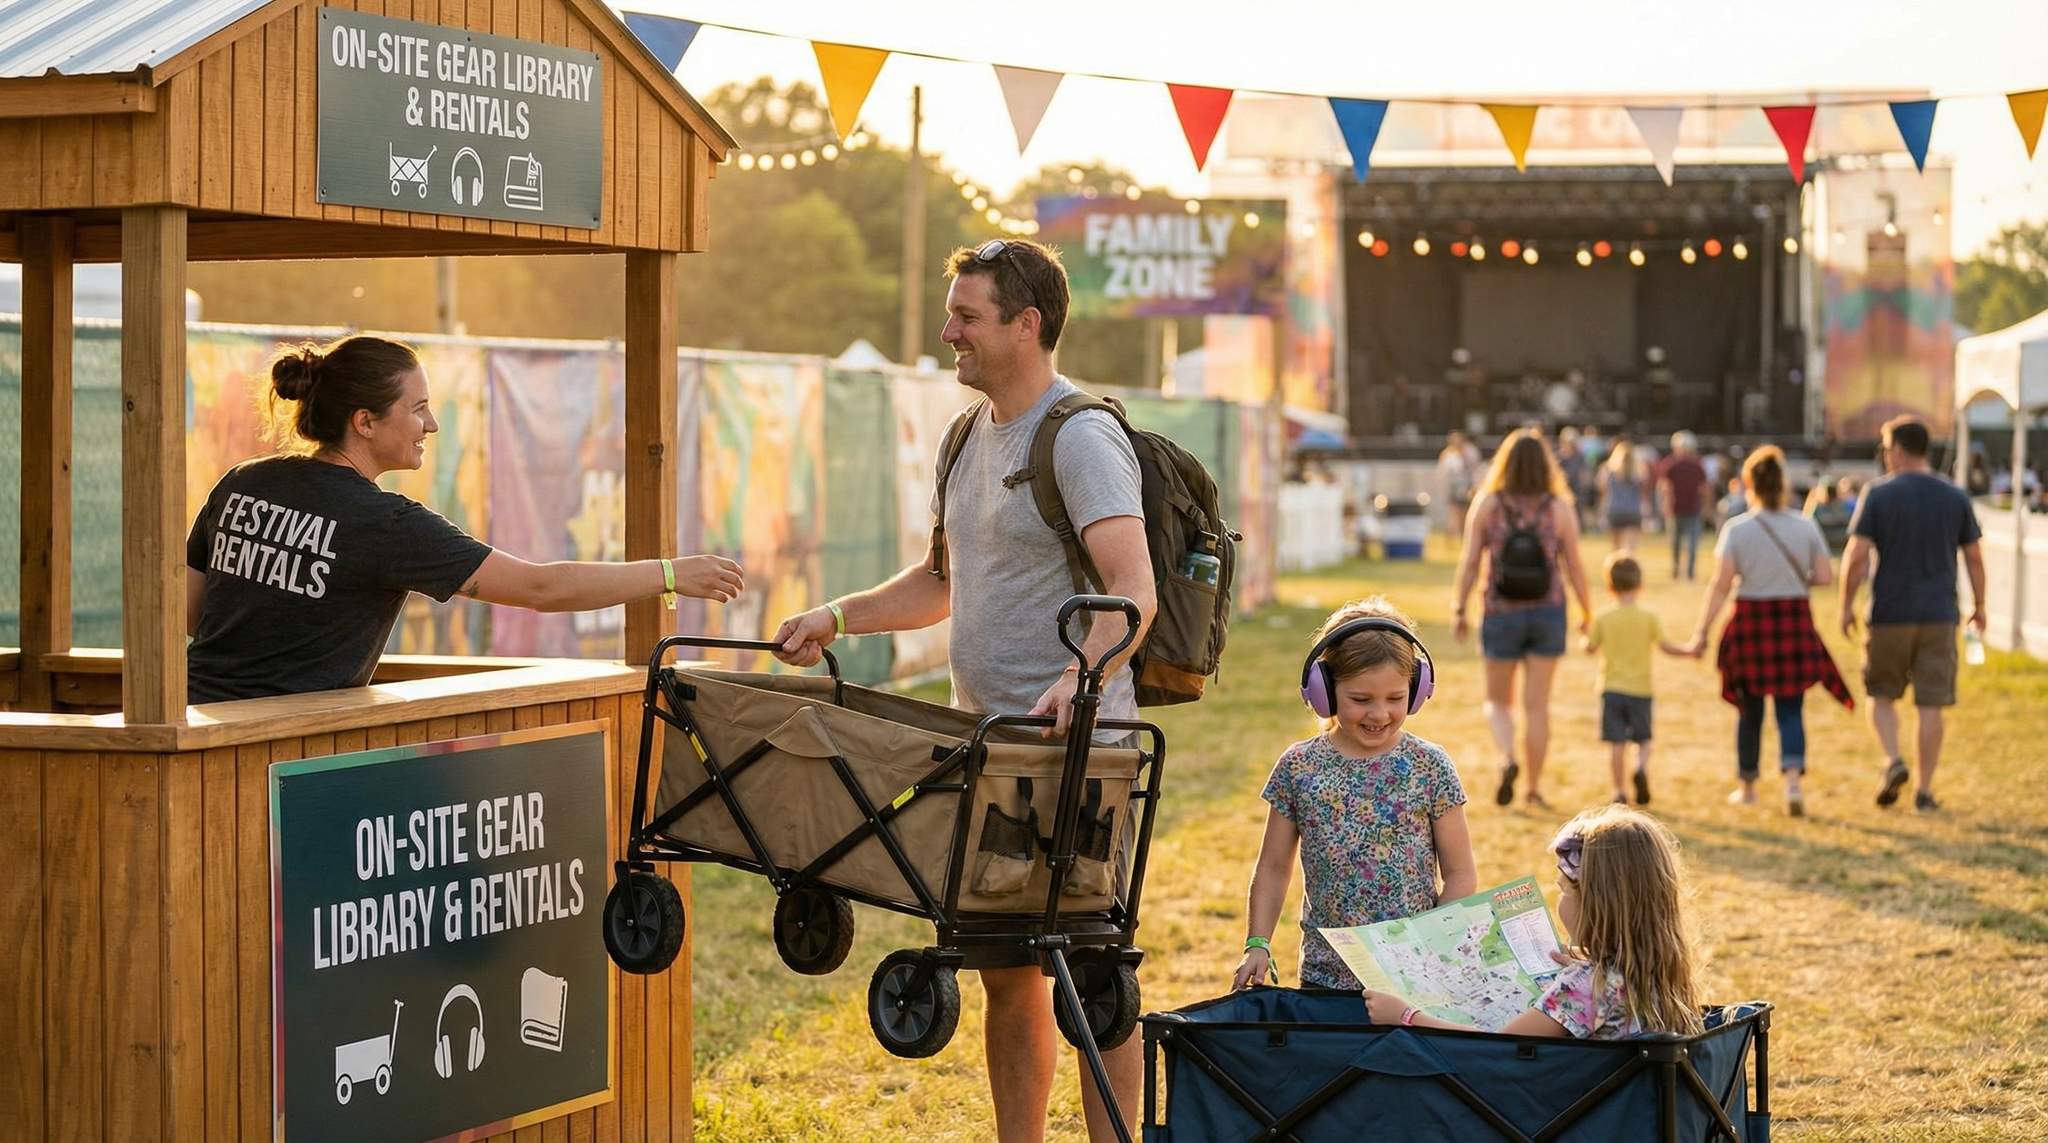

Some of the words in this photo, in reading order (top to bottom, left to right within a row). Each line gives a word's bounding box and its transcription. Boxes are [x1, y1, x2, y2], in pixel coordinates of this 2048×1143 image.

[332, 25, 429, 79] ON-SITE
[436, 41, 497, 89] GEAR
[503, 51, 594, 102] LIBRARY
[405, 86, 424, 127] &
[430, 89, 530, 140] RENTALS
[1085, 213, 1235, 257] FAMILY
[1104, 255, 1216, 300] ZONE
[218, 492, 337, 560] FESTIVAL
[210, 531, 330, 599] RENTALS
[356, 803, 469, 881] ON-SITE
[476, 791, 545, 860] GEAR
[313, 885, 436, 970] LIBRARY
[444, 880, 463, 943] &
[470, 857, 584, 938] RENTALS
